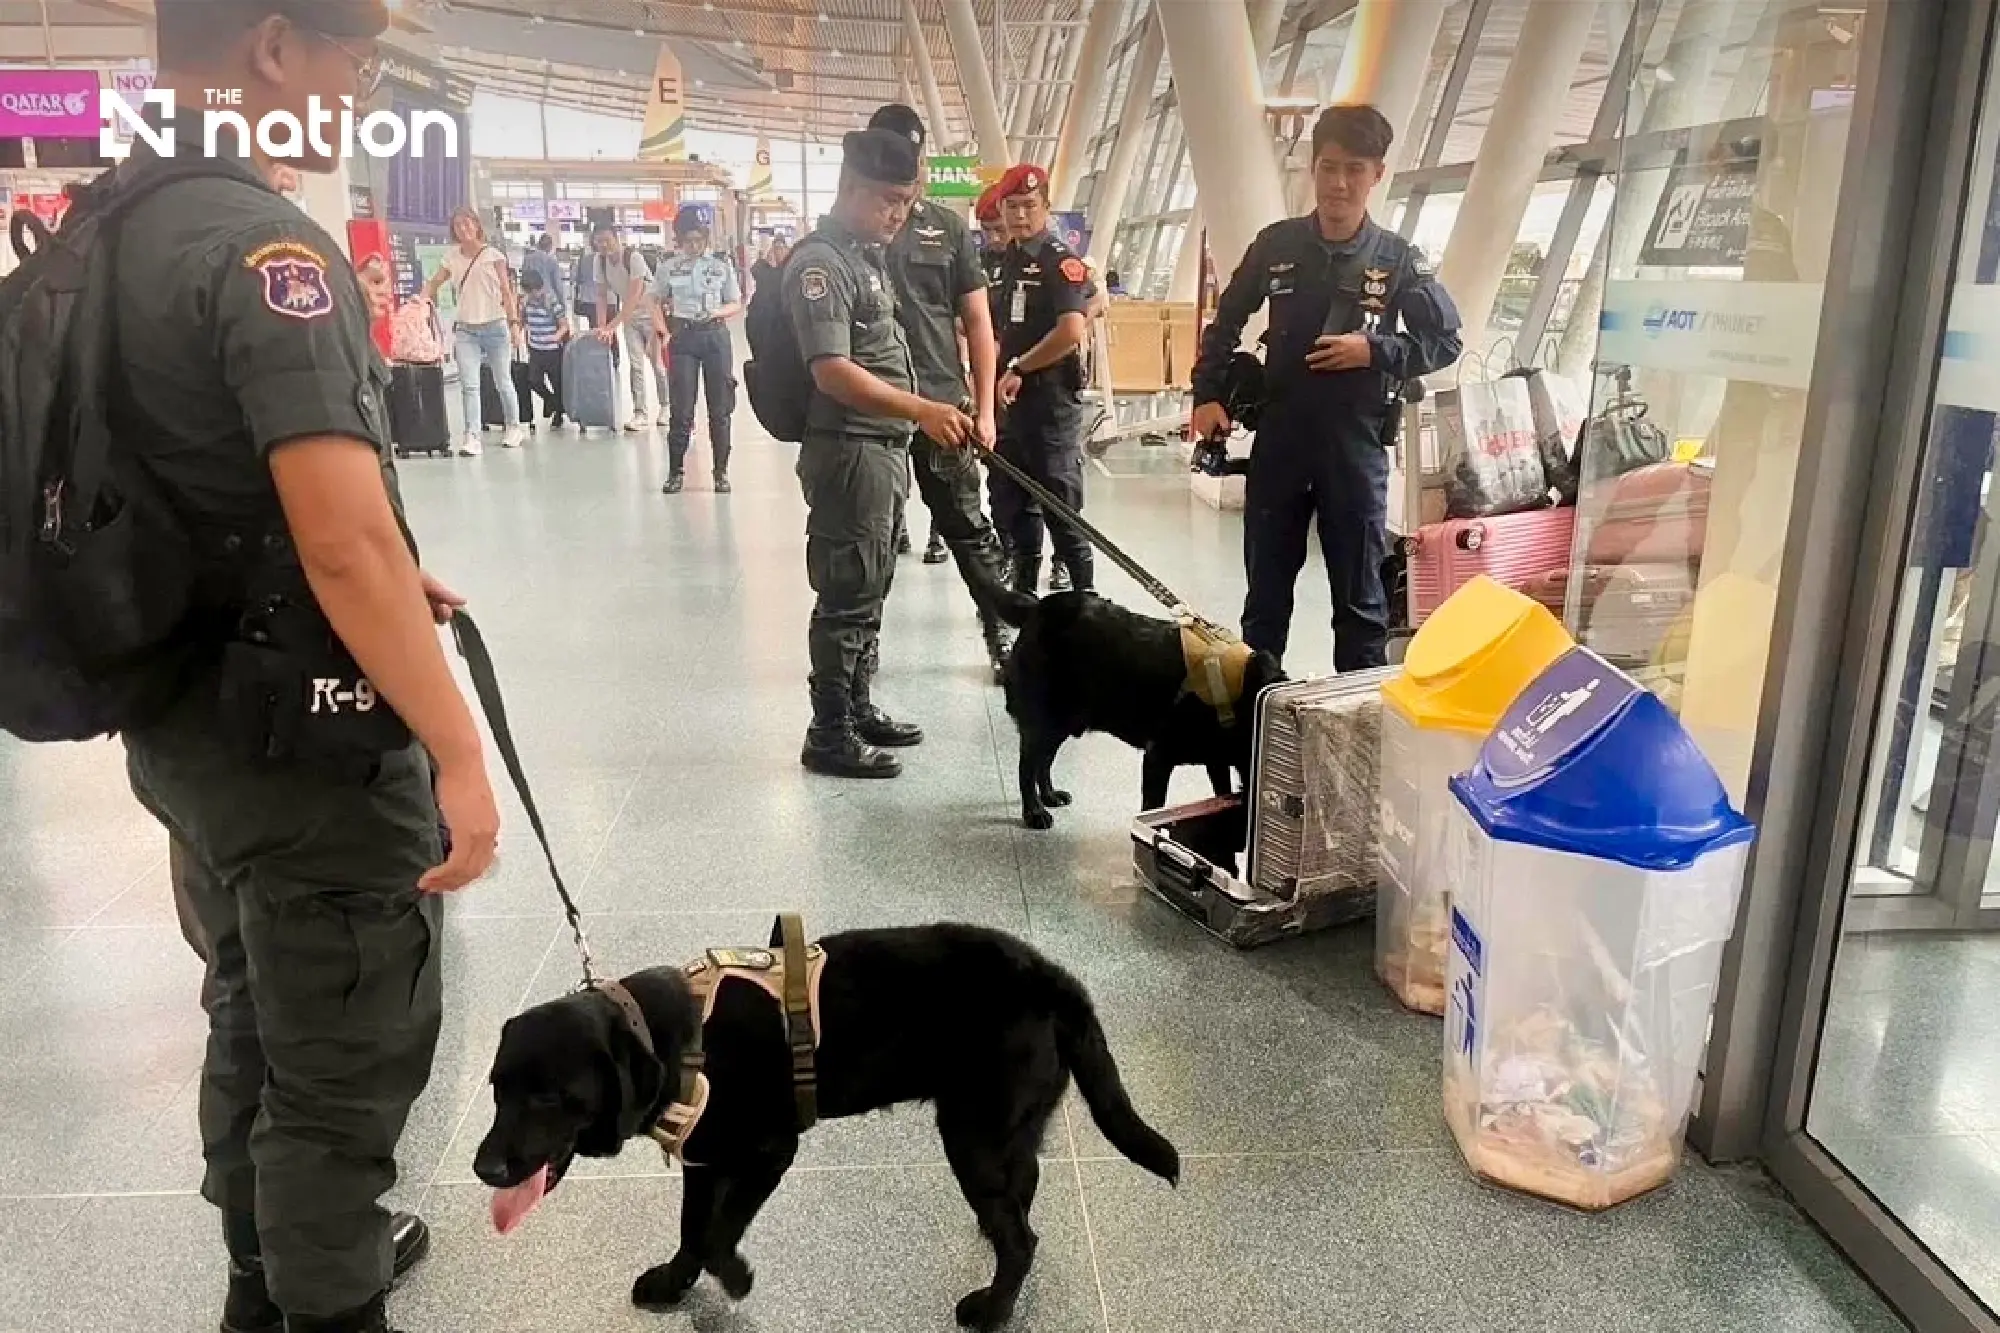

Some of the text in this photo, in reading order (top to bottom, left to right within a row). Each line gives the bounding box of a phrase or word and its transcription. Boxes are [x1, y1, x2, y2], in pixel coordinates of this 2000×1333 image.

[659, 78, 678, 104] E
[2, 93, 64, 112] QATAR
[756, 150, 770, 165] G
[928, 167, 976, 184] HAN
[1666, 310, 1698, 330] AOT
[311, 678, 375, 713] K-9
